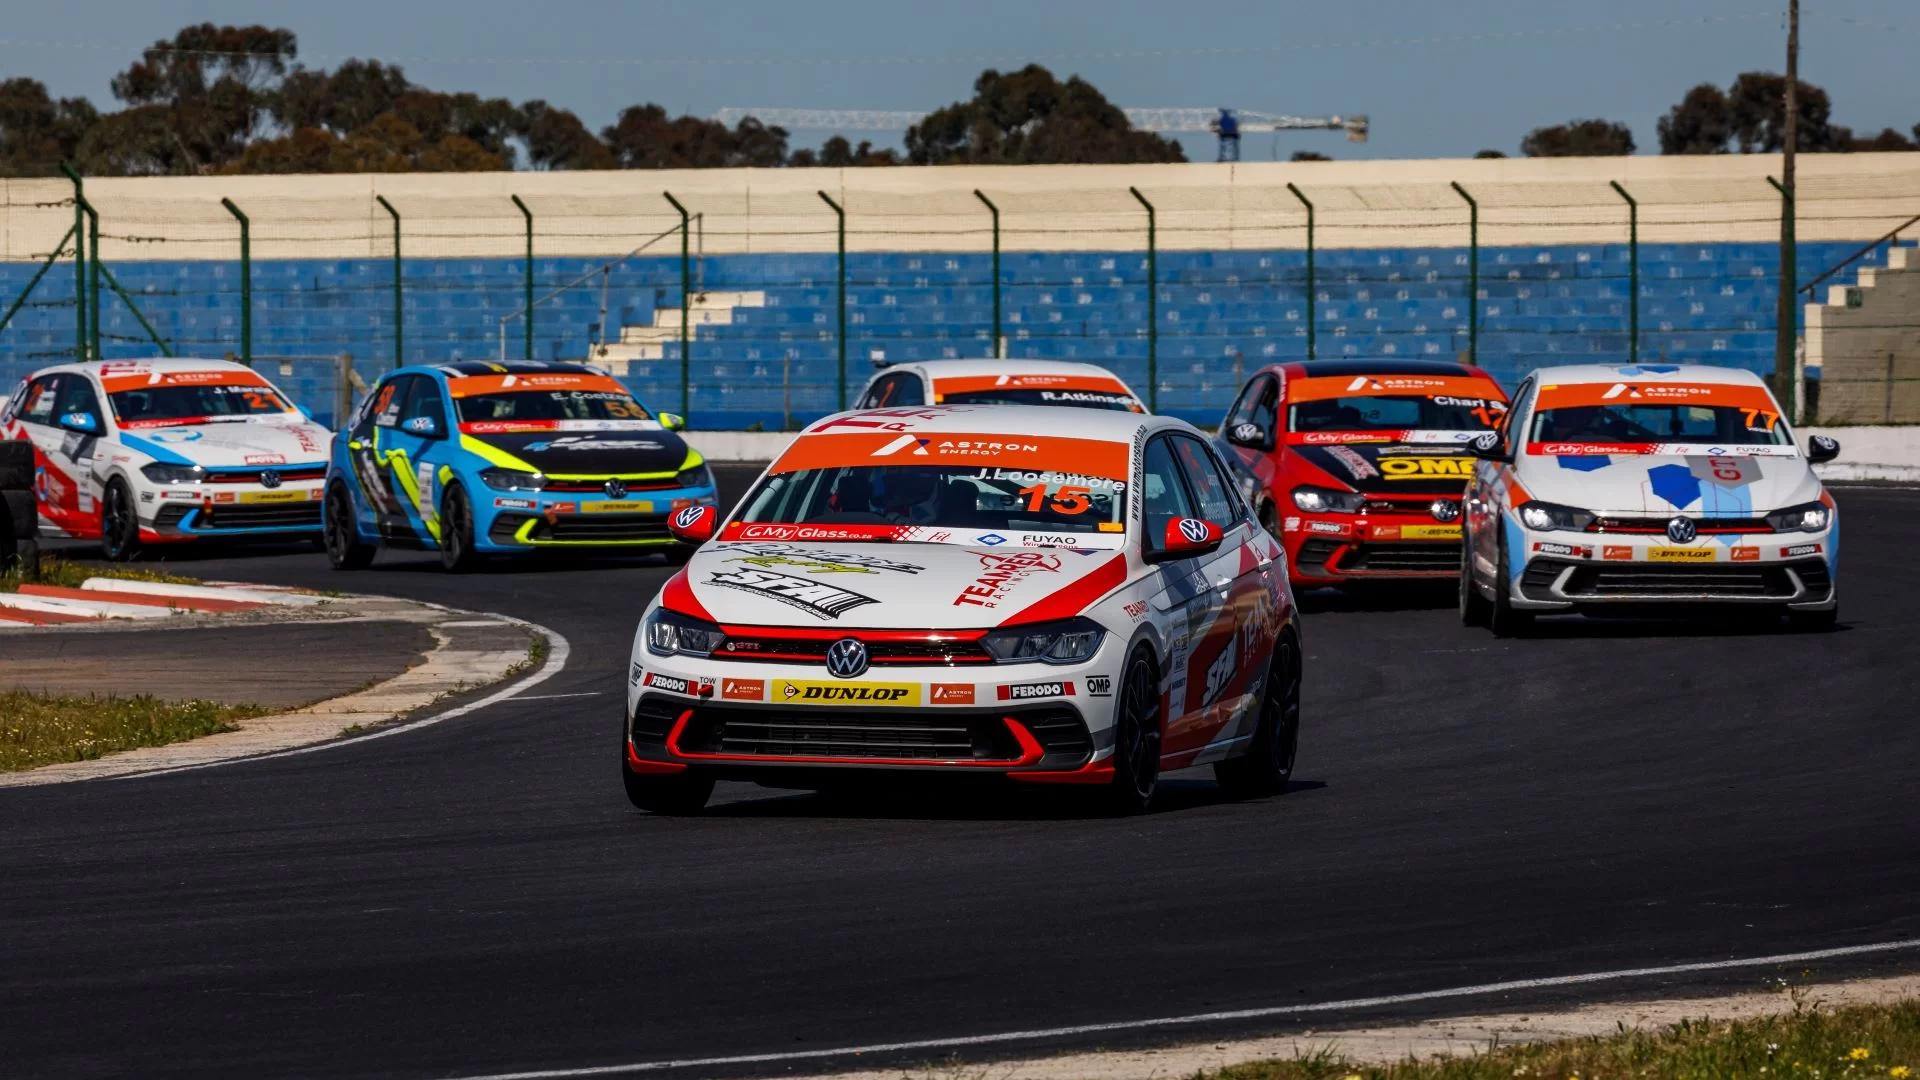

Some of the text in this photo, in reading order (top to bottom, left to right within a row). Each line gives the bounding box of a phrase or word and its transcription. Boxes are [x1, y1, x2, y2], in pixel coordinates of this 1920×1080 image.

[1644, 387, 1711, 395] ASTRON
[1434, 396, 1485, 408] Charl
[1739, 407, 1779, 431] 77
[938, 440, 1038, 453] ASTRON
[970, 468, 1126, 492] J.Loosemore
[1018, 484, 1091, 515] 15
[1022, 535, 1077, 545] FUYAO
[1660, 550, 1712, 558] DUNLOP
[650, 675, 688, 692] FERODO
[1086, 679, 1111, 694] OMP
[802, 685, 910, 701] DUNLOP
[1012, 685, 1061, 697] FERODO
